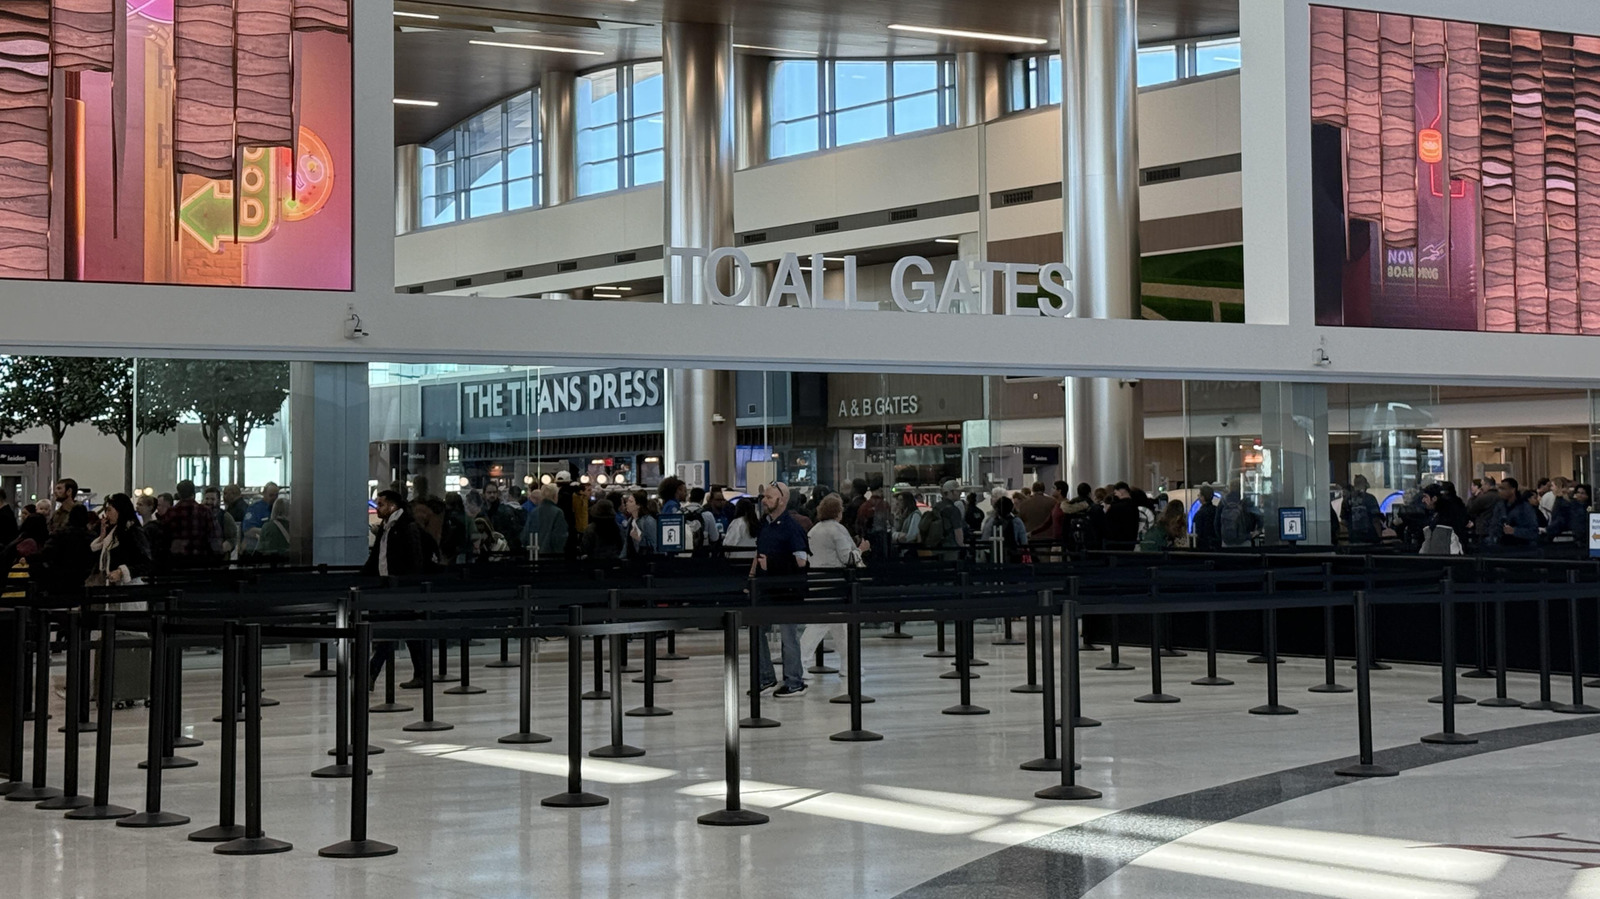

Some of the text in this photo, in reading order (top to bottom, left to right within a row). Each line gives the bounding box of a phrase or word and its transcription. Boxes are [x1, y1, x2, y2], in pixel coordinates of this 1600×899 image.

[666, 247, 1074, 318] TO ALL GATES
[464, 369, 660, 418] THE TITANS PRESS
[838, 395, 918, 417] A & B GATES
[903, 433, 943, 446] MUSIC
